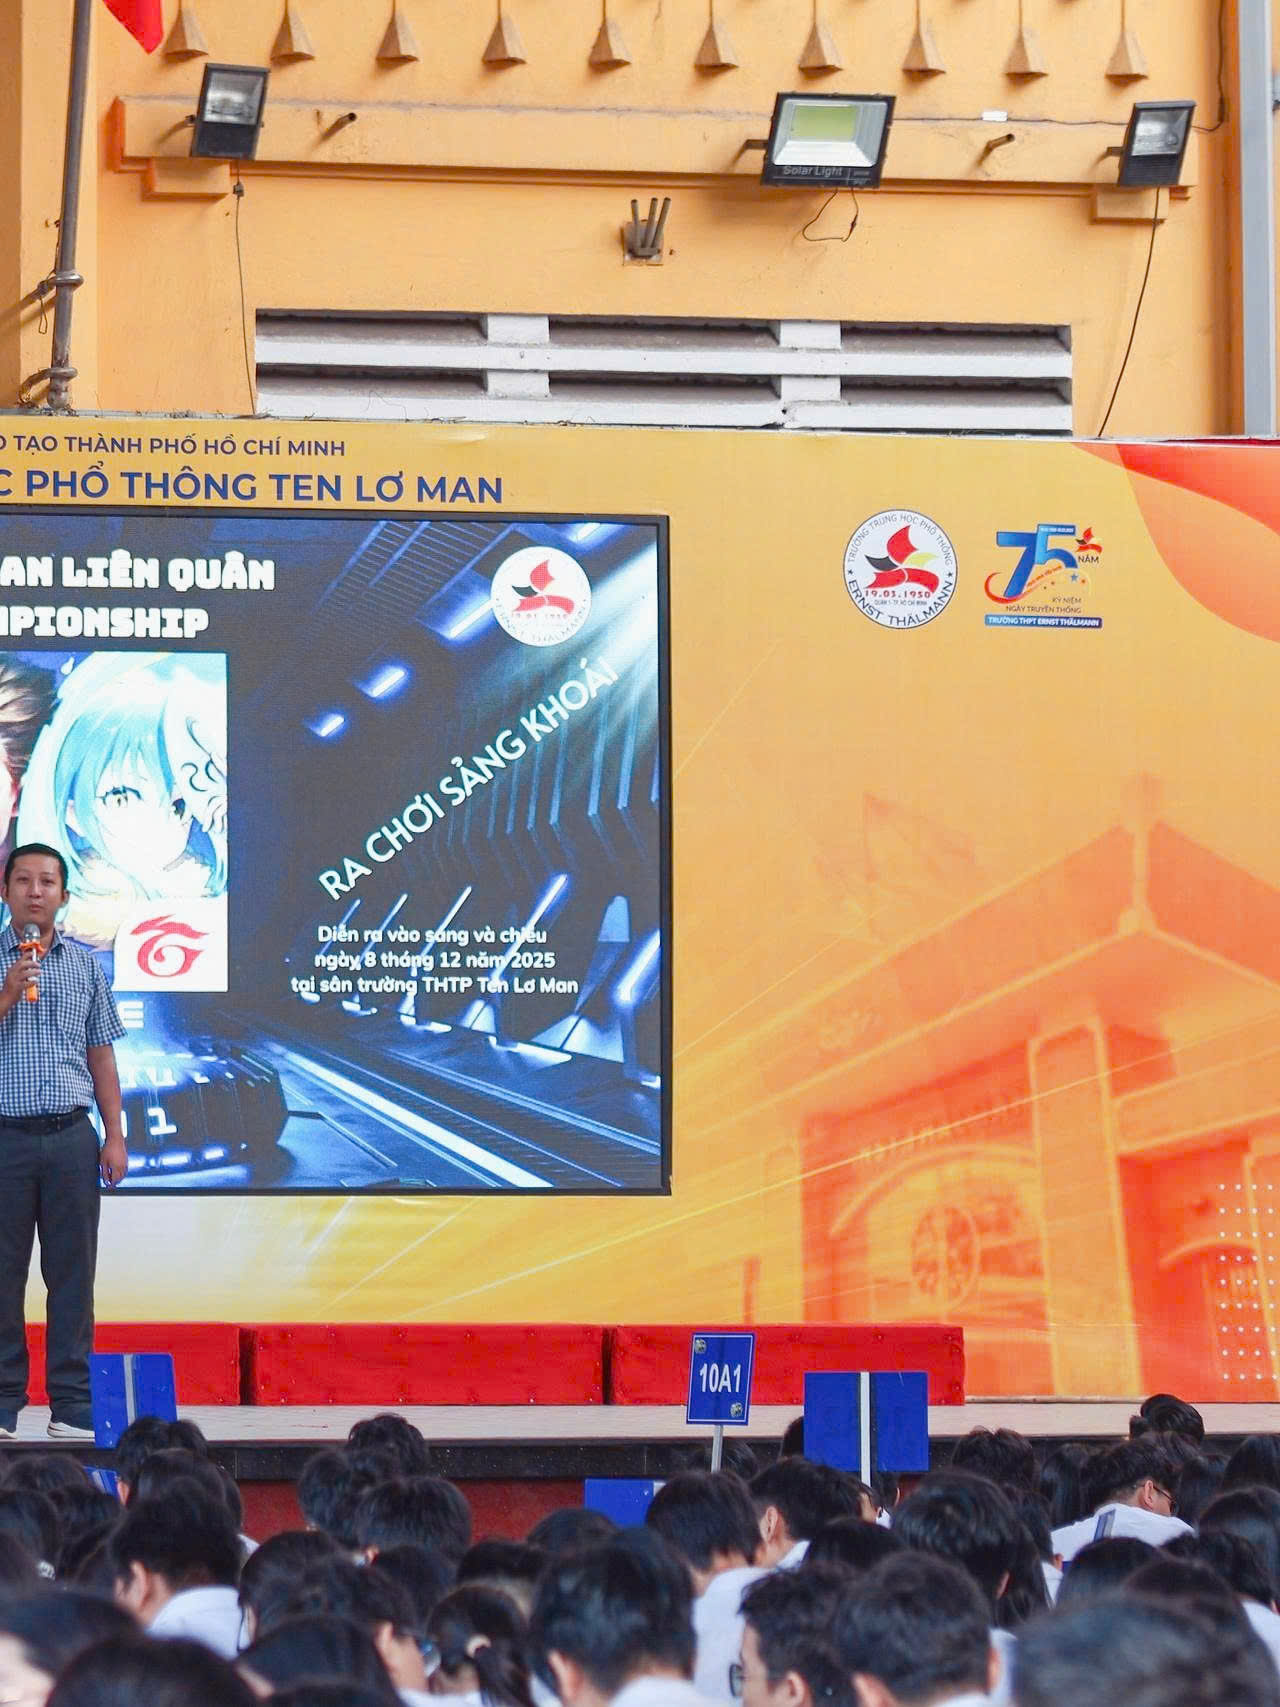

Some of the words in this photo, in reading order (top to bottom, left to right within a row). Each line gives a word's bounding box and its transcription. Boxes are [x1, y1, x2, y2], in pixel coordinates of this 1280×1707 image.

[13, 435, 58, 457] TẠO
[64, 432, 142, 454] THÀNH
[149, 433, 197, 455] PHỐ
[204, 434, 236, 456] HỒ
[243, 435, 280, 456] CHÍ
[288, 439, 345, 457] MINH
[26, 460, 109, 499] PHỔ
[120, 465, 257, 501] THÔNG
[268, 473, 342, 502] TEN
[356, 470, 404, 503] LƠ
[417, 476, 502, 504] MAN
[62, 548, 160, 589] LIÊN
[167, 550, 276, 592] QUÂN
[996, 524, 1078, 598] 75
[848, 579, 883, 620] ERNST
[318, 857, 373, 901] RA
[366, 792, 446, 863] CHƠI
[439, 729, 527, 806] SẢNG
[520, 656, 619, 742] KHOÁI
[363, 929, 383, 943] ra
[387, 925, 420, 943] vào
[473, 925, 496, 943] và
[315, 950, 360, 971] ngày
[364, 951, 377, 968] 8
[380, 950, 434, 972] tháng
[440, 951, 461, 968] 12
[466, 951, 507, 968] năm
[511, 951, 556, 969] 2025
[319, 975, 353, 993] sân
[357, 975, 418, 997] trường
[422, 976, 473, 993] THTP
[514, 977, 536, 993] Lơ
[540, 977, 579, 993] Man
[699, 1363, 742, 1393] 10A1
